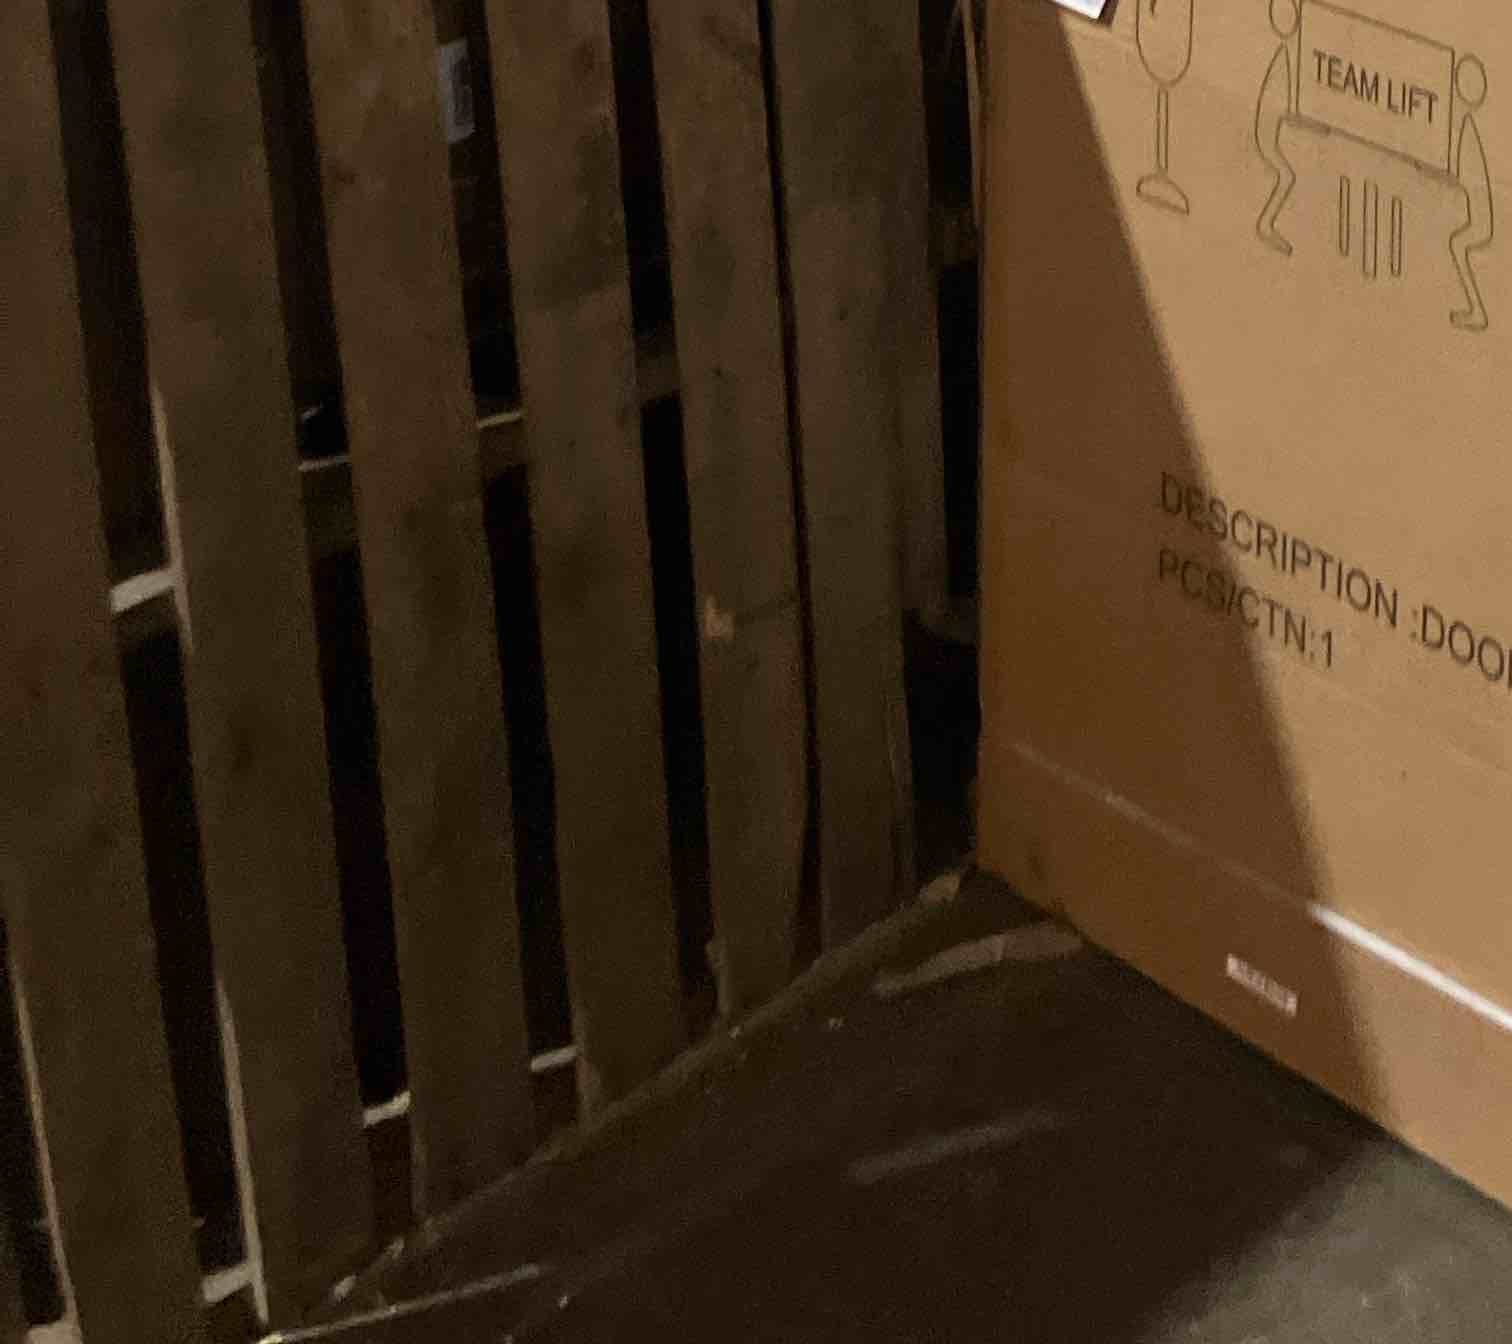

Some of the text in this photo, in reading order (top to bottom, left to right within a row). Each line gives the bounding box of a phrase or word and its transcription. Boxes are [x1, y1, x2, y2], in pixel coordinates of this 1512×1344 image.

[1312, 49, 1439, 124] TEAM LIFT
[1160, 471, 1399, 628] DESCRIPTION
